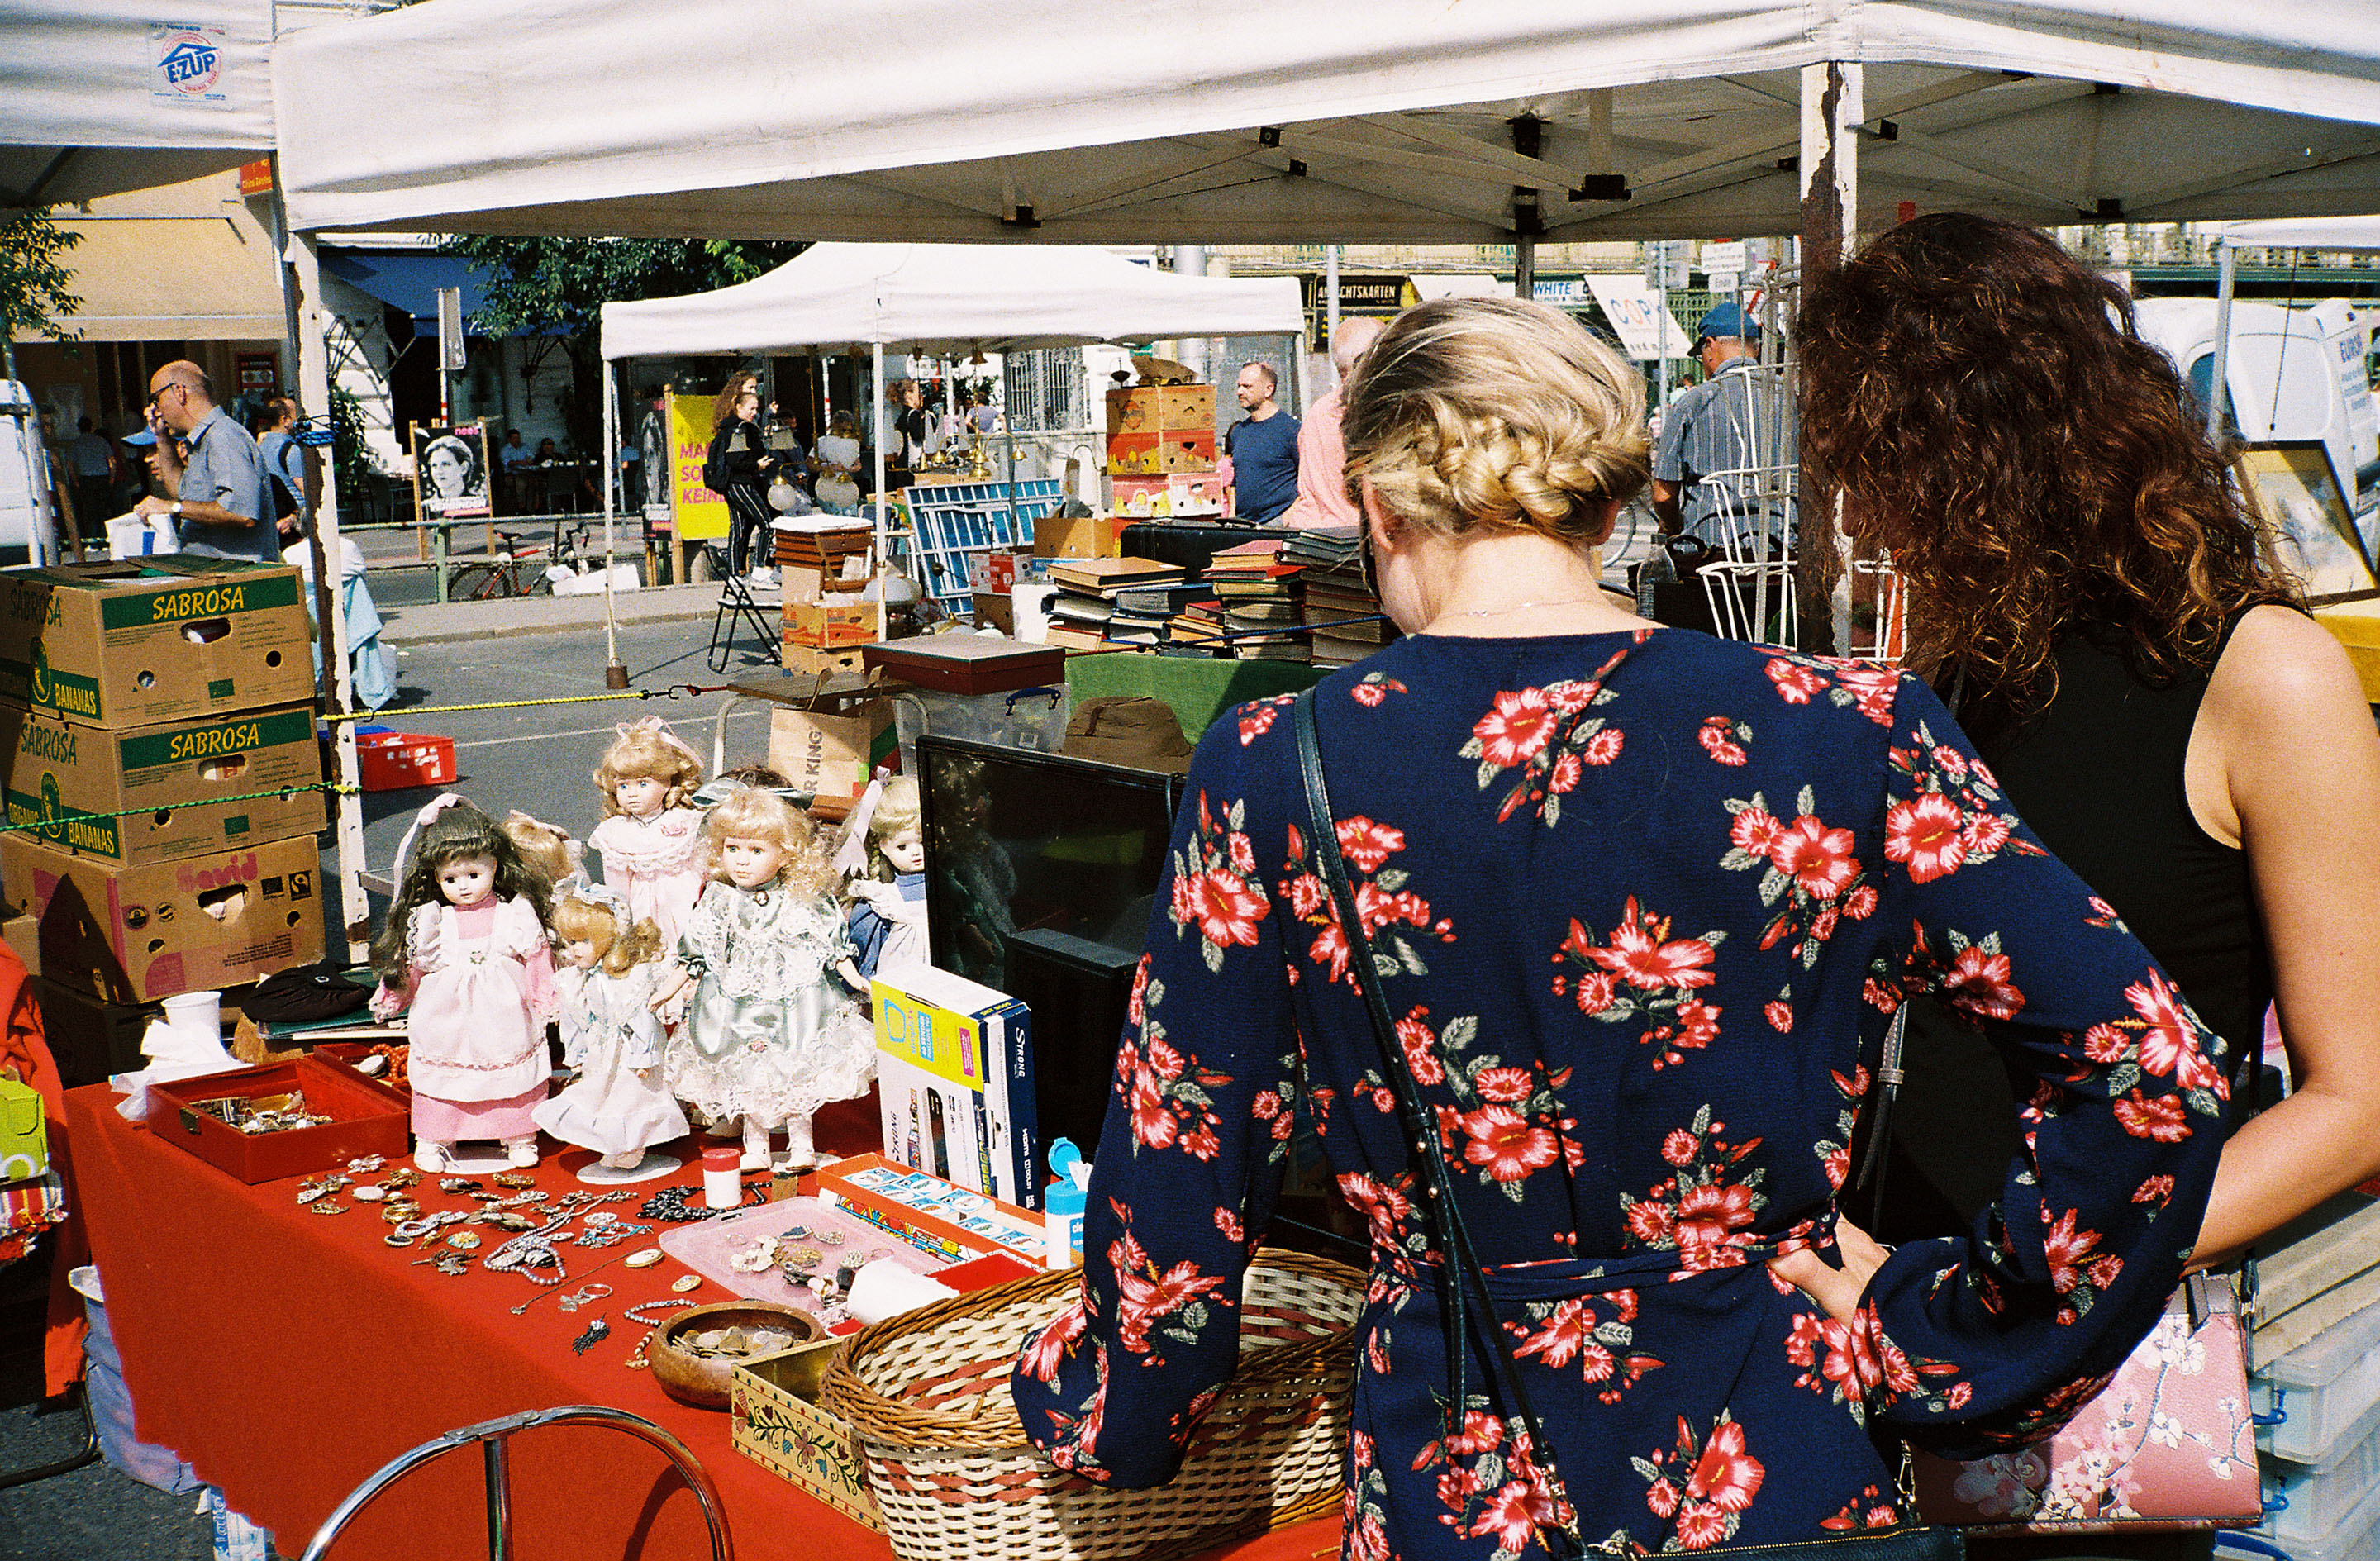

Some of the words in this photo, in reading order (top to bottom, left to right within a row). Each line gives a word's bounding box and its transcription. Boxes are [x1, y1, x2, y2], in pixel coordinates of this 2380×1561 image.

[1534, 283, 1572, 295] WHITE
[152, 588, 245, 620] SABROSA
[55, 683, 97, 715] BANANAS
[21, 723, 78, 765] SABROSA
[170, 723, 259, 759] SABROSA
[805, 731, 822, 775] KING
[69, 821, 114, 854] BANANAS
